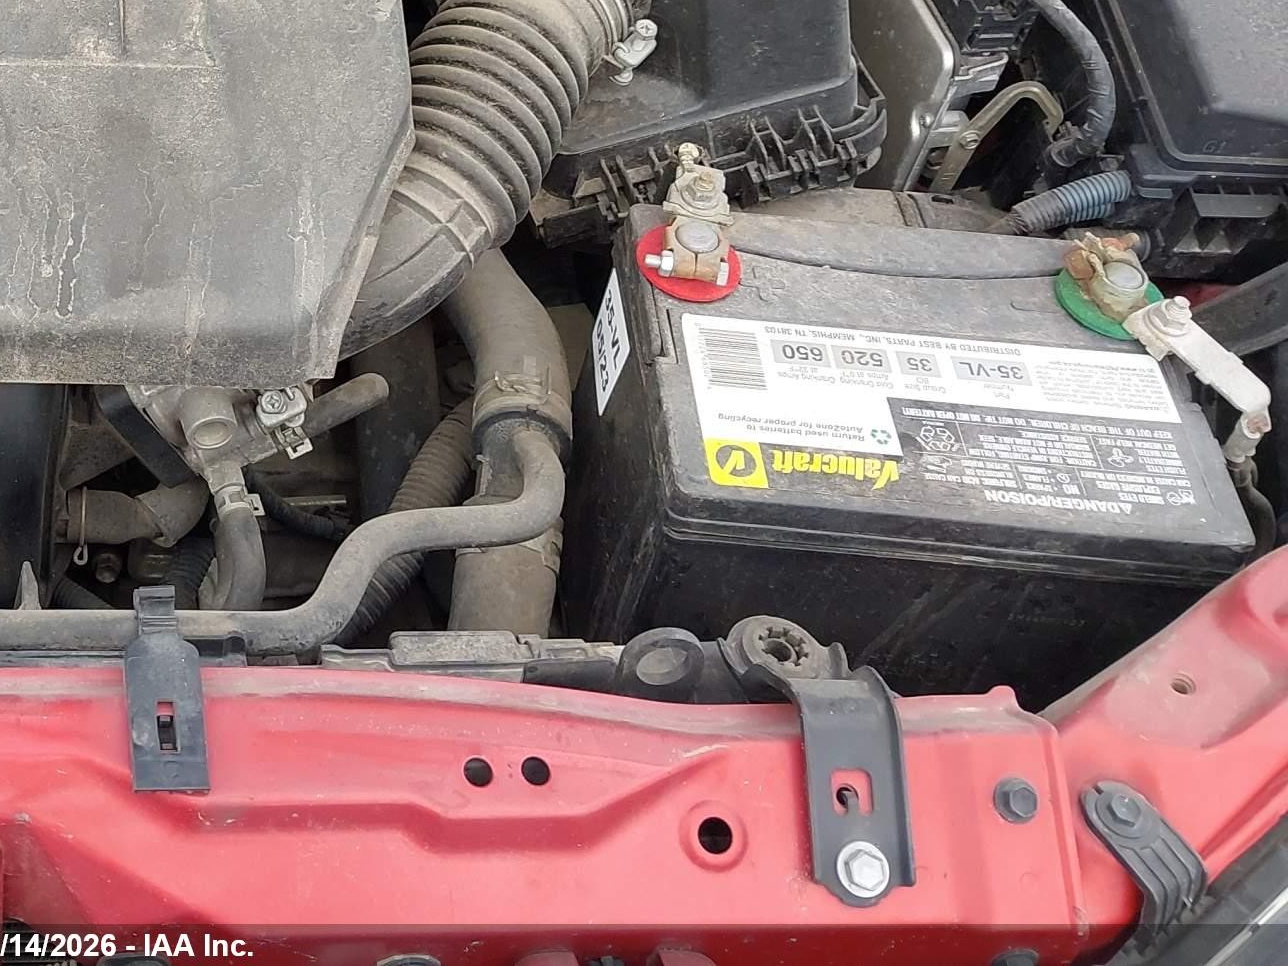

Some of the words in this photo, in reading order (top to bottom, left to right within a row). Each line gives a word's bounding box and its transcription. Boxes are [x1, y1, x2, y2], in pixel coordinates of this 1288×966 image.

[605, 289, 621, 371] 35-VL
[764, 326, 792, 335] 38103
[919, 340, 942, 349] BEST
[959, 344, 1021, 356] DISTRIBUTED
[596, 319, 610, 393] 05/23
[782, 345, 823, 362] 650
[841, 350, 883, 367] 520
[907, 357, 932, 371] 35
[959, 362, 1024, 380] 35-VL
[718, 413, 761, 424] recycling
[764, 417, 796, 427] proper
[747, 424, 756, 432] to
[758, 426, 802, 436] batteries
[805, 429, 828, 438] used
[816, 423, 863, 433] AutoZone
[832, 432, 864, 441] Return
[770, 449, 899, 491] Valucraft
[984, 489, 1120, 514] DANGER/POISON
